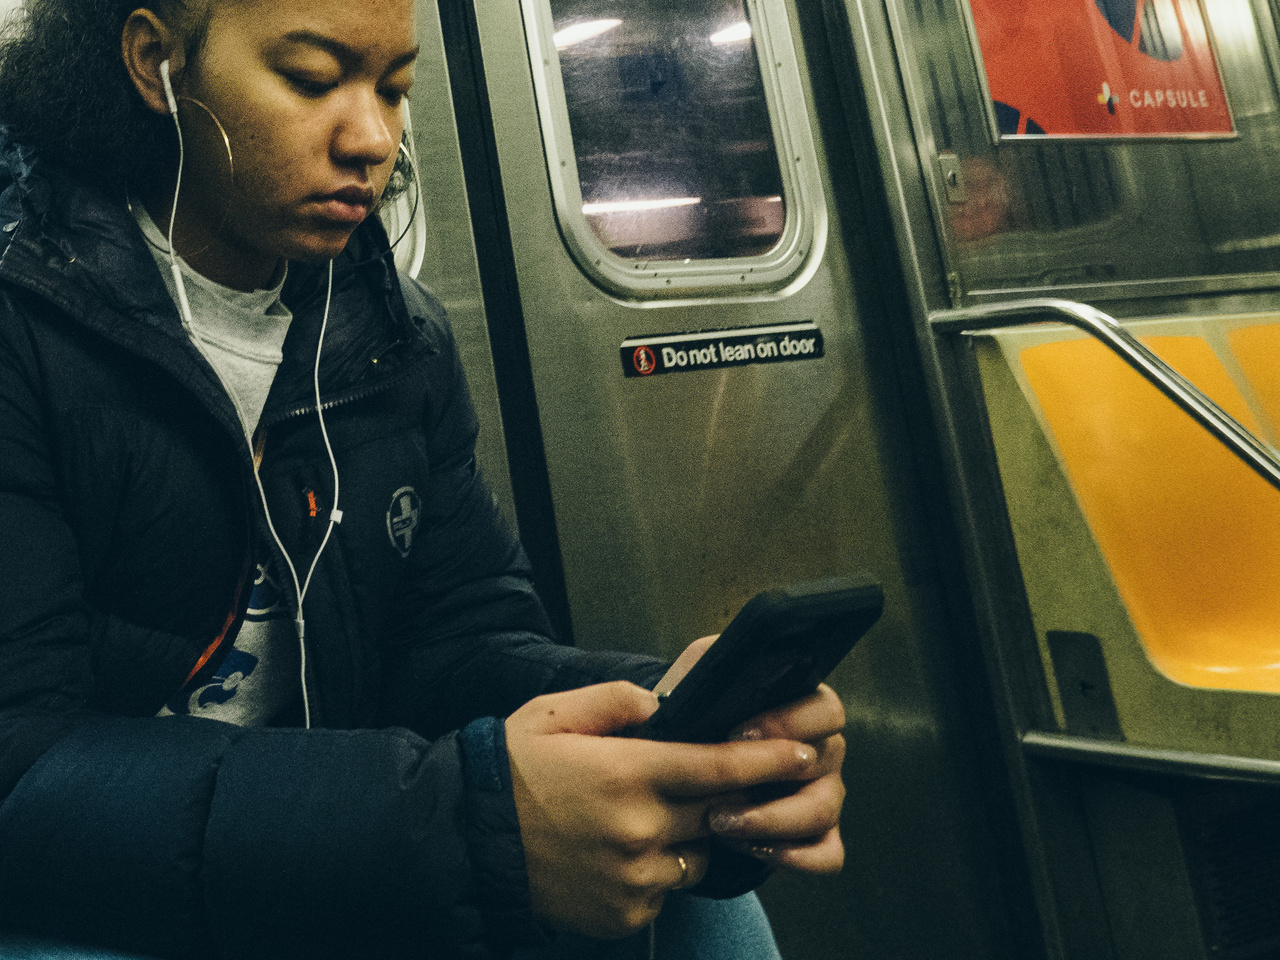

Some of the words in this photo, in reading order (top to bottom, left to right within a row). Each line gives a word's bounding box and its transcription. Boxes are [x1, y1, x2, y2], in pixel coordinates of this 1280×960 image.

[1129, 89, 1208, 108] CAPSULE
[662, 347, 688, 368] Do
[688, 344, 718, 365] not
[719, 342, 755, 362] lean
[756, 341, 778, 358] on
[779, 336, 816, 356] door
